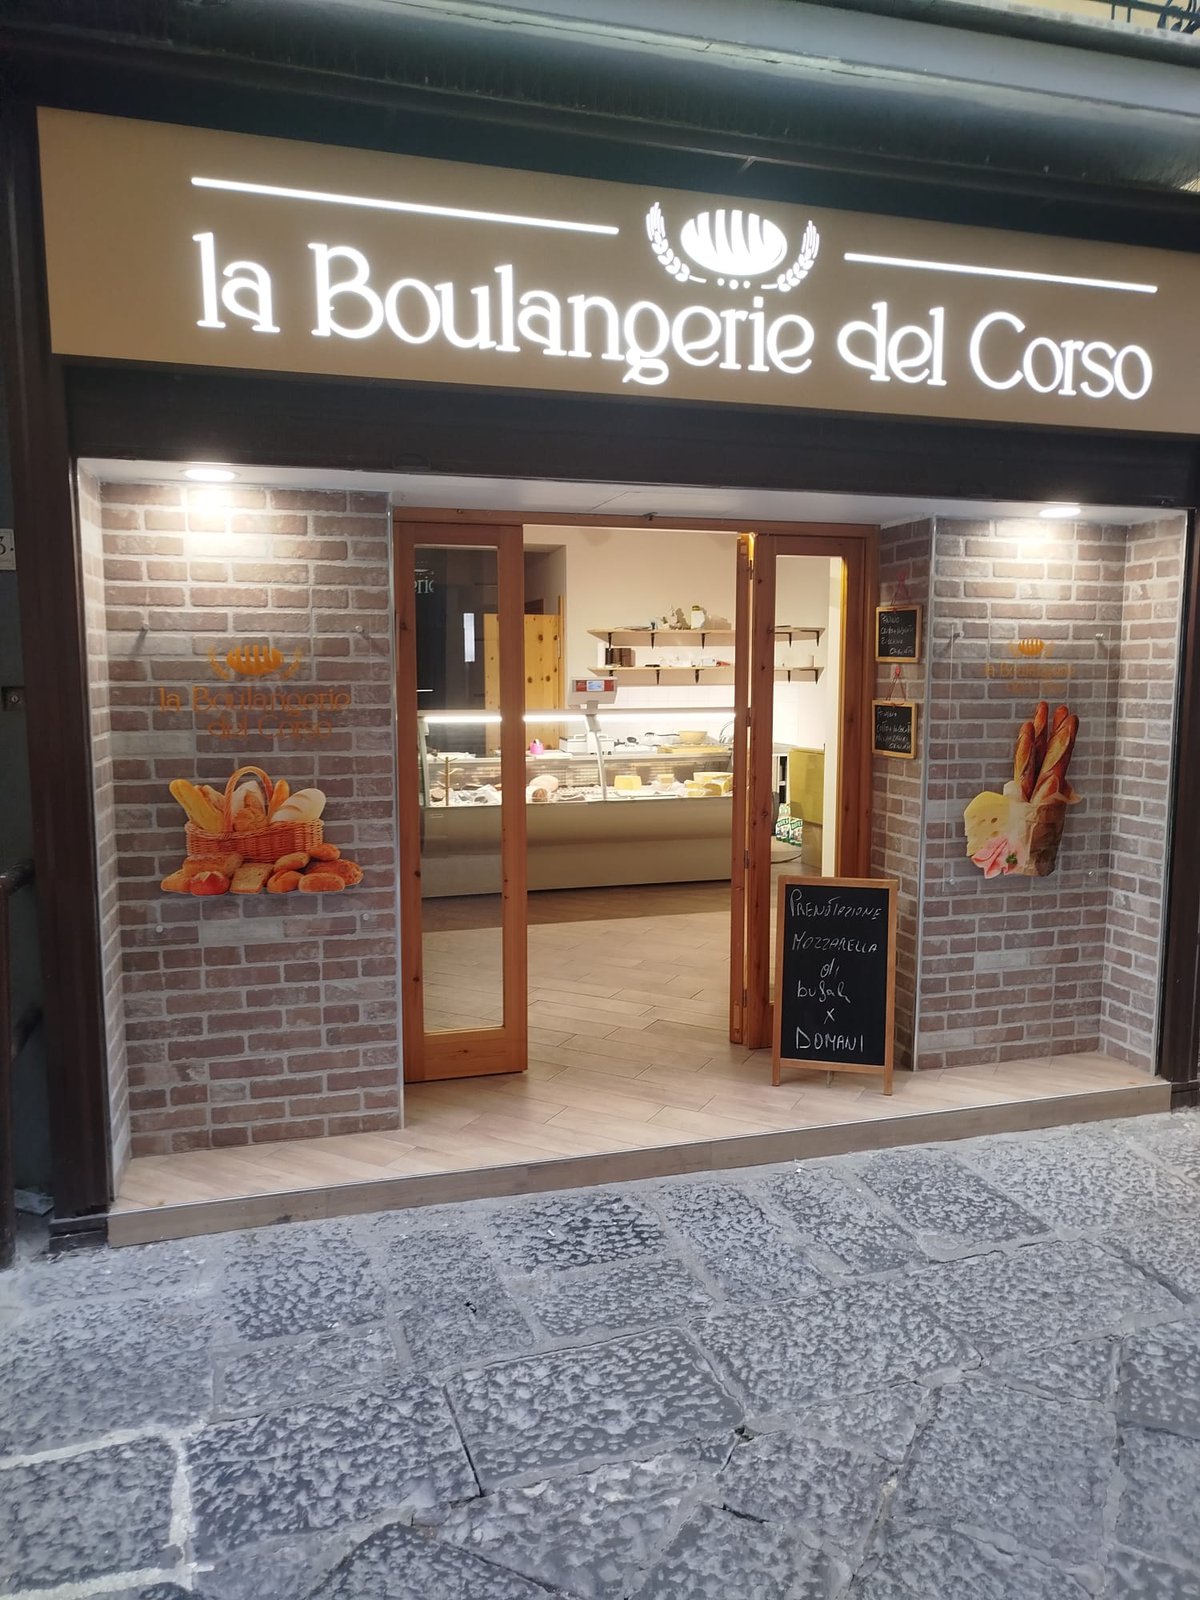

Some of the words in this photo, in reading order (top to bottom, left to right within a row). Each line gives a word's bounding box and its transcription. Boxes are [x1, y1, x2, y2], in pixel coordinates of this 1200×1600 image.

[192, 232, 281, 334] la
[307, 243, 816, 386] Boulangerie
[837, 301, 948, 387] del
[969, 311, 1154, 400] Corso
[792, 931, 878, 953] MOZZARELLA
[795, 1026, 864, 1053] DOMANI
